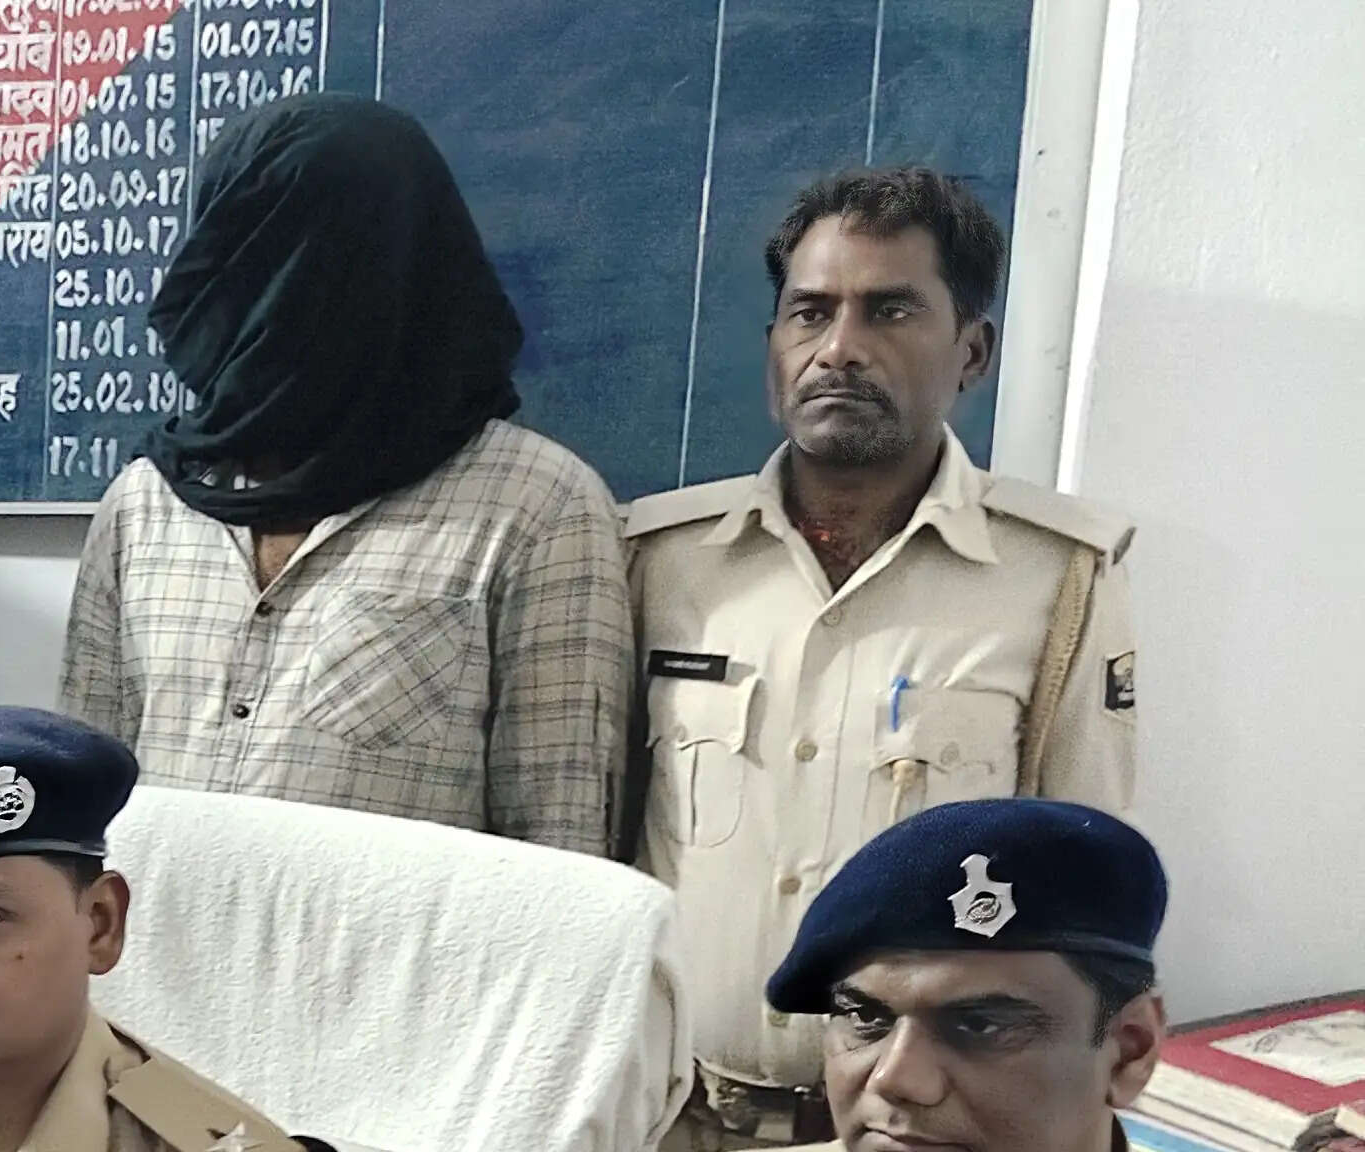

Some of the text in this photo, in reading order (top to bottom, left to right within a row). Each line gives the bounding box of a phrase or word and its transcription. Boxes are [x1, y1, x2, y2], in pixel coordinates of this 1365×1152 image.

[61, 117, 176, 165] 18.10.16
[59, 167, 187, 211] 20.09.17
[56, 215, 179, 259] 05.10.17
[55, 266, 169, 307] 25.10.1
[51, 369, 177, 414] 25.02.19
